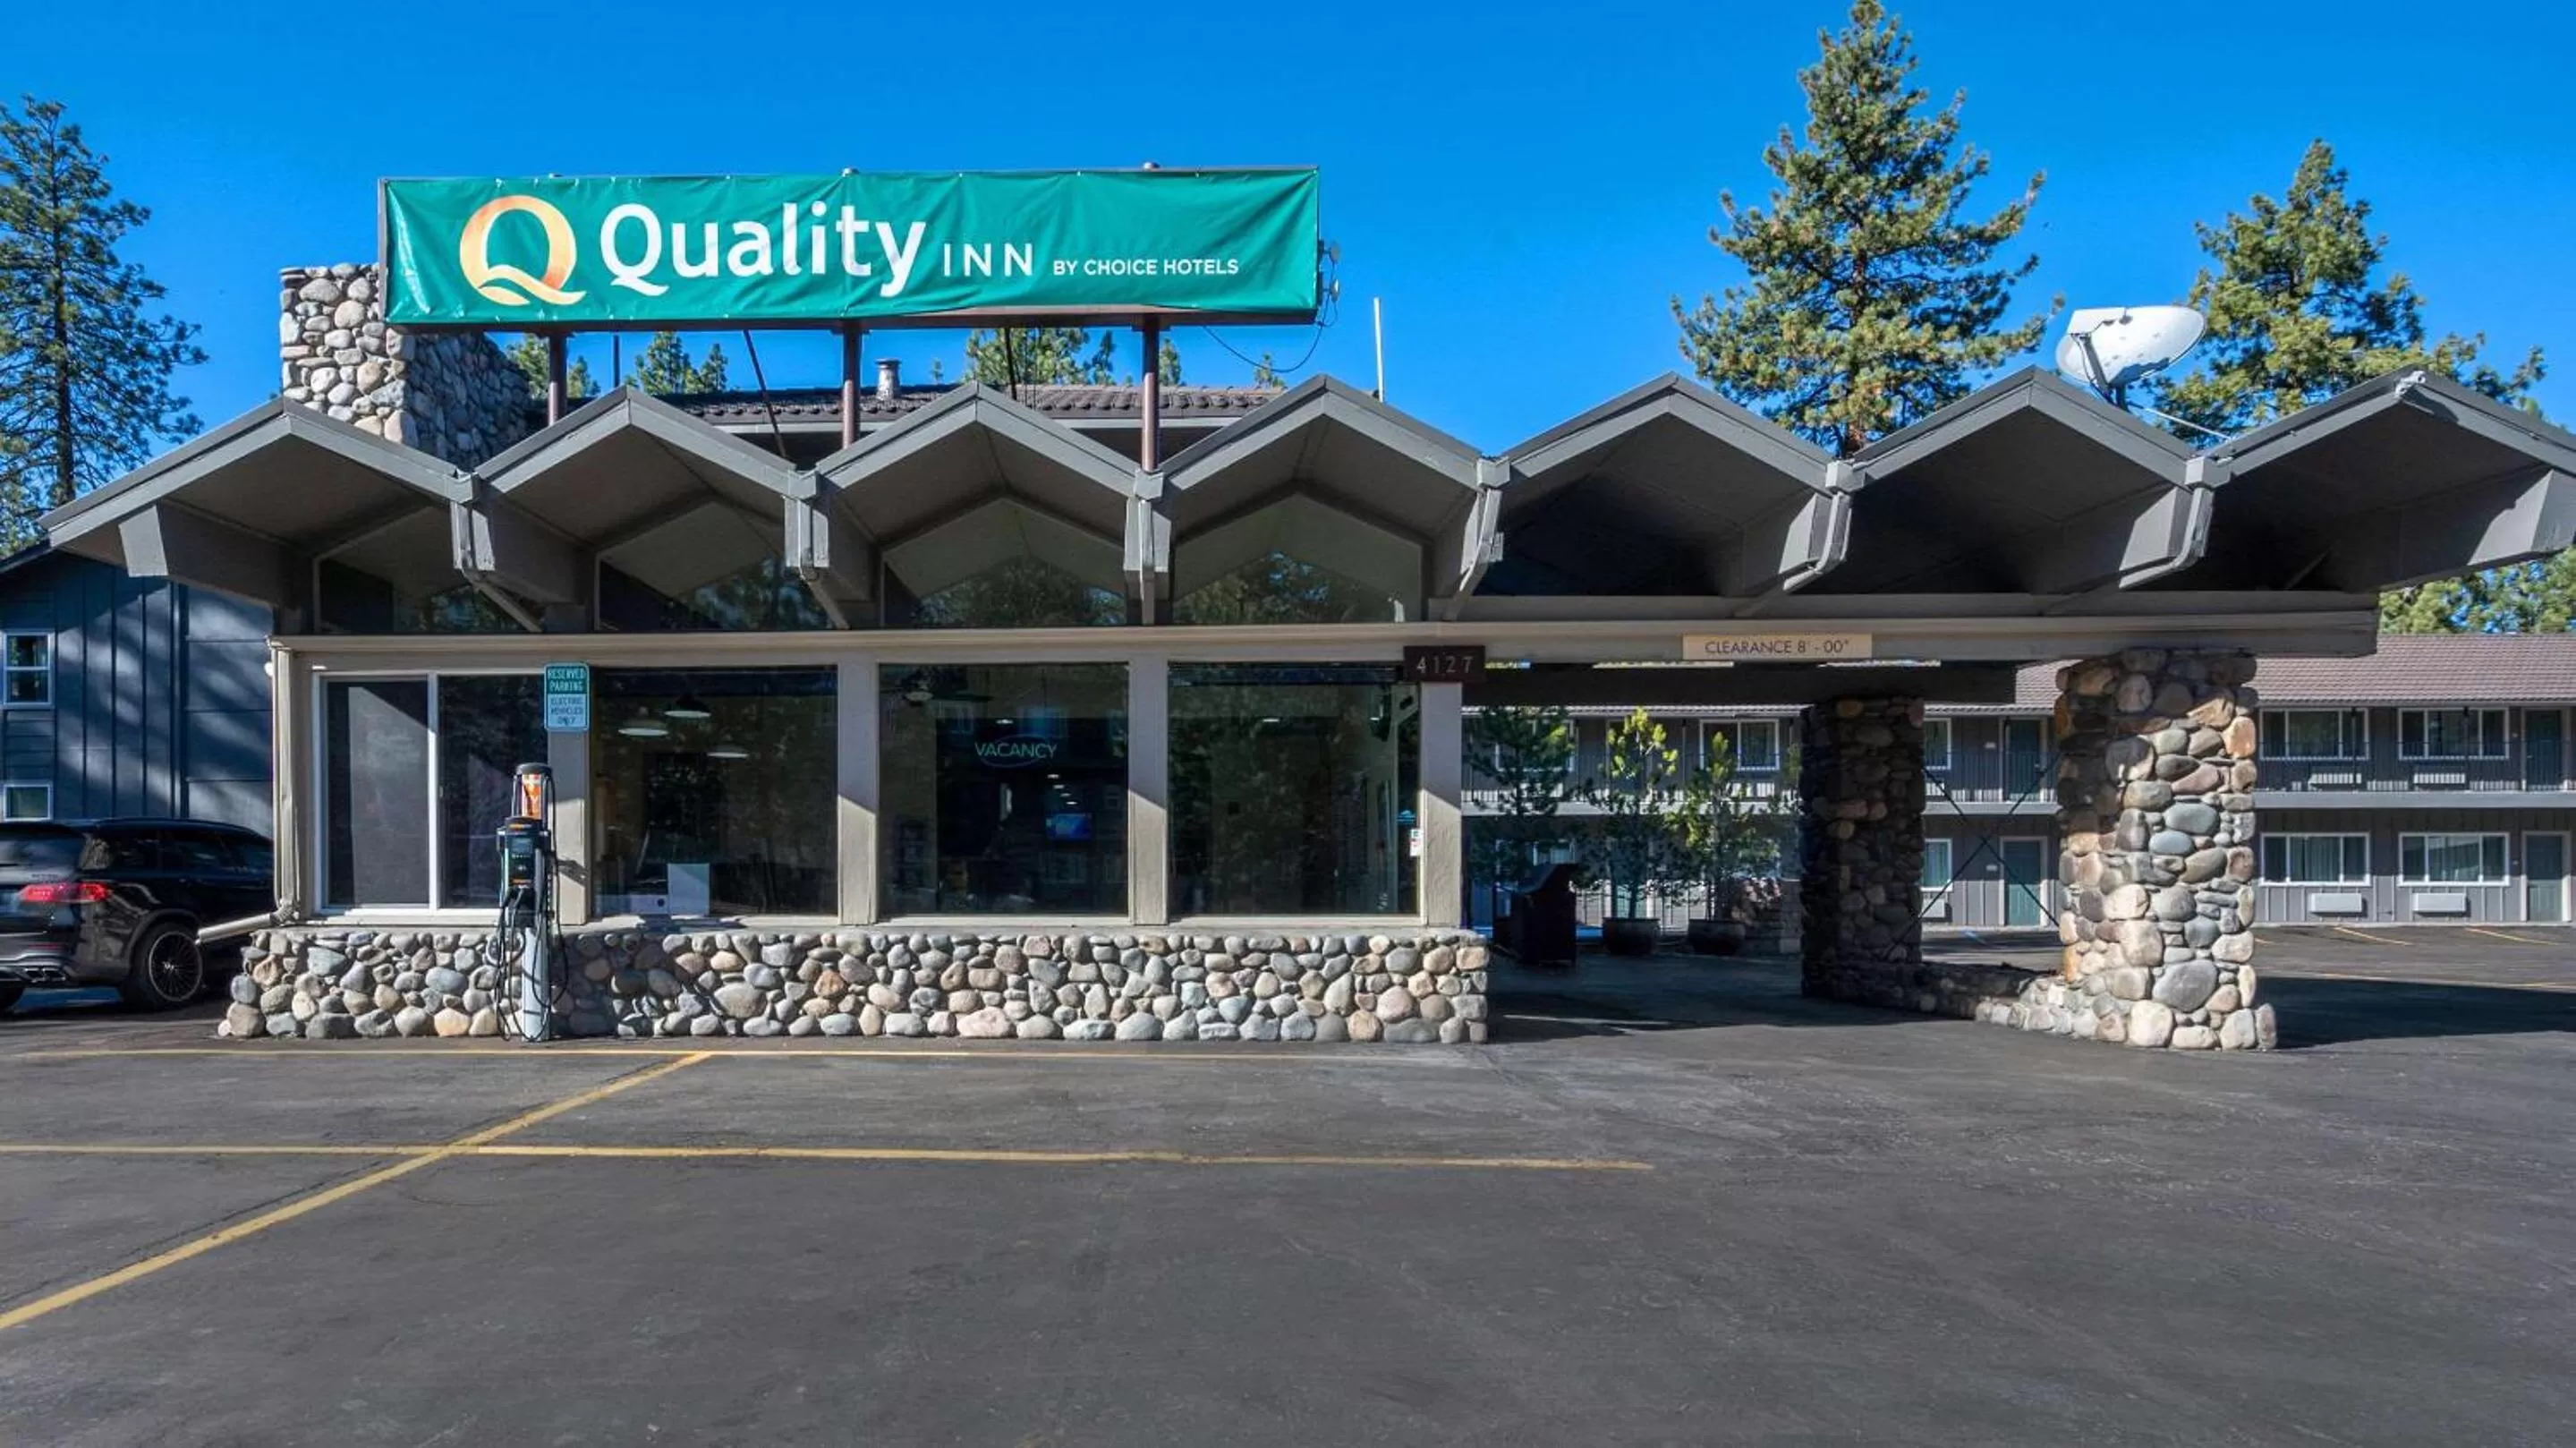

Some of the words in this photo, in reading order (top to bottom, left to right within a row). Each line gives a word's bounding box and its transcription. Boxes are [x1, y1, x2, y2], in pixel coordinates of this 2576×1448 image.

[459, 194, 587, 306] Q
[599, 202, 926, 298] Quality
[944, 243, 1033, 277] INN
[1053, 260, 1080, 277] BY
[1084, 259, 1158, 277] CHOICE
[1164, 258, 1239, 276] HOTELS
[1705, 640, 1791, 654] CLEARANCE
[1416, 655, 1474, 674] 4127
[548, 668, 586, 679] RESERVED
[549, 680, 584, 692] PARKING
[973, 741, 1058, 759] VACANCY
